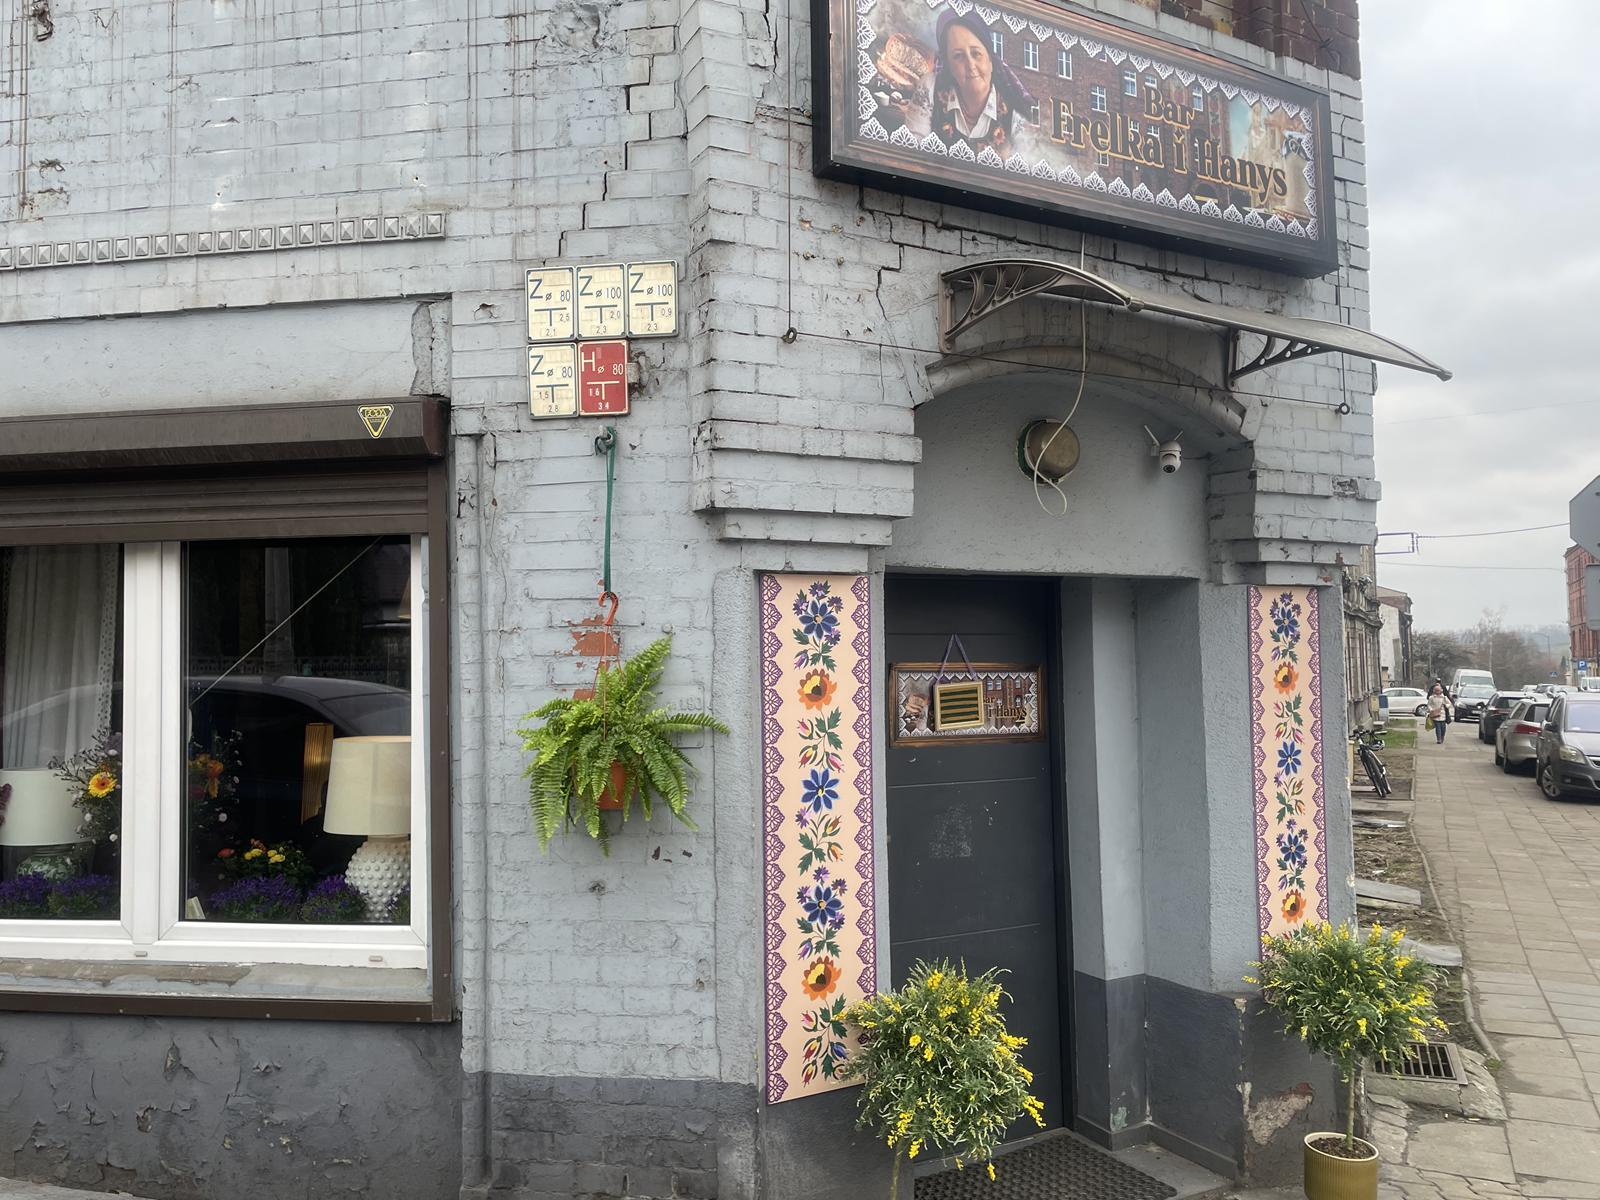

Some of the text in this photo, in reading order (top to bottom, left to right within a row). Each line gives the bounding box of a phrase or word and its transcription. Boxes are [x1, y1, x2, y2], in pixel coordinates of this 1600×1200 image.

[1144, 84, 1195, 129] Bar
[1049, 97, 1288, 203] Frelka i Hanys
[529, 279, 543, 299] Z
[560, 290, 571, 301] 80
[579, 275, 593, 296] Z
[606, 287, 622, 299] 100
[630, 272, 644, 293] Z
[657, 284, 673, 297] 100
[530, 355, 544, 375] Z
[561, 367, 573, 378] 80
[581, 352, 596, 372] H
[613, 364, 624, 375] 80
